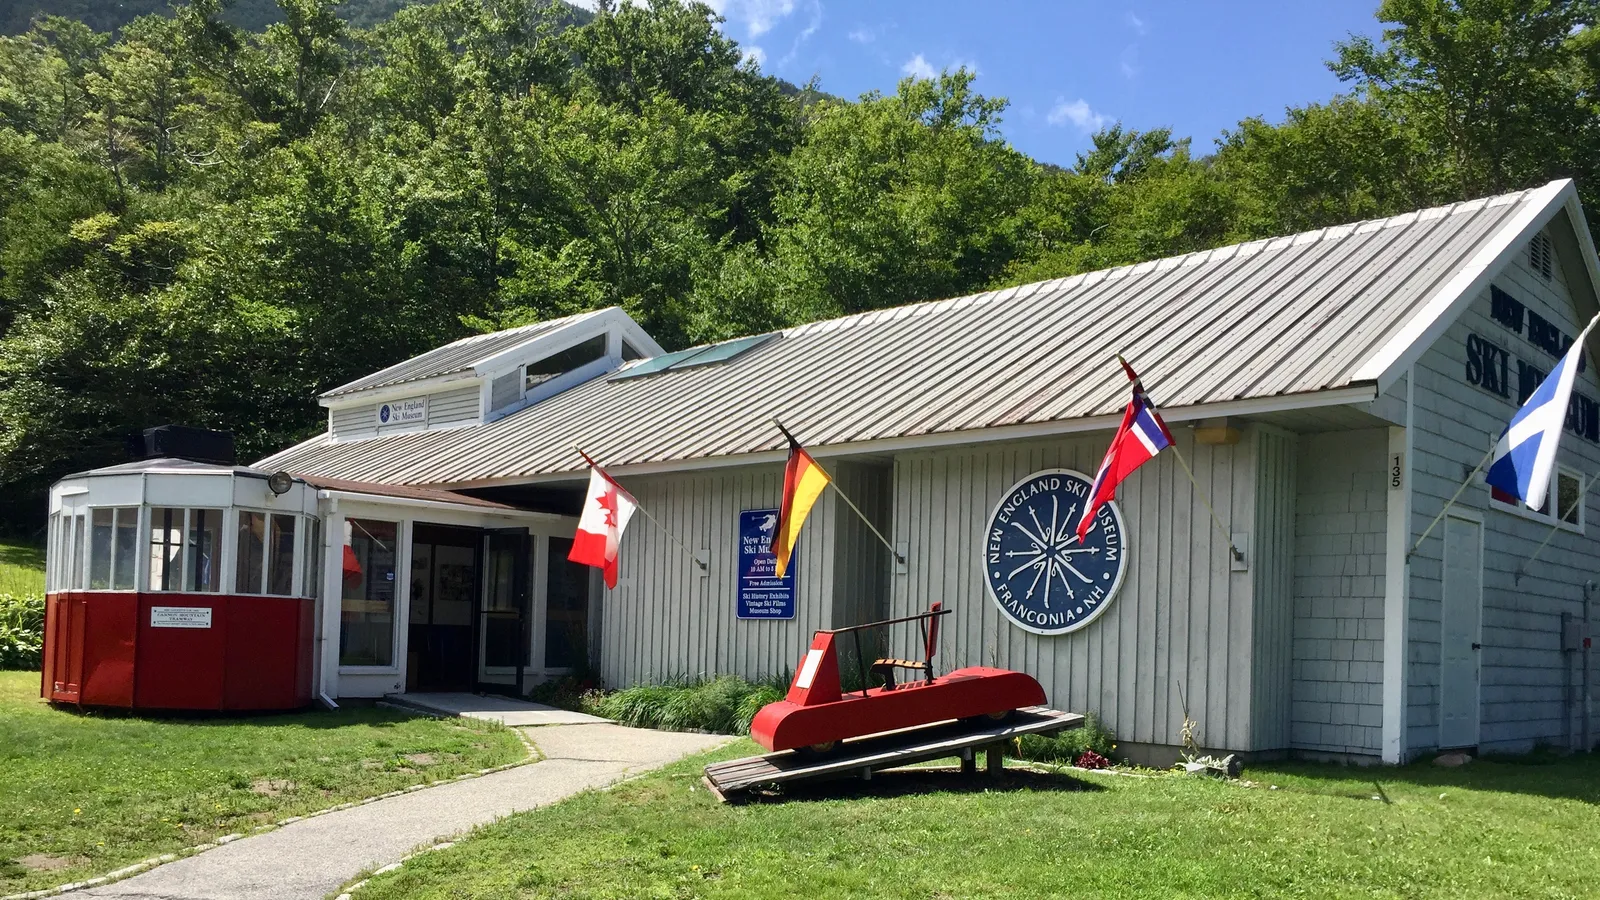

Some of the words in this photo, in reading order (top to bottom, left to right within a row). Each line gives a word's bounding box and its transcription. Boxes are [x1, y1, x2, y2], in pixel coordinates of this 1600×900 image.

[1466, 333, 1510, 399] SKI
[1516, 359, 1600, 444] MEUM
[391, 404, 402, 412] New
[404, 399, 425, 411] England
[392, 412, 400, 421] Ski
[401, 411, 423, 420] Museum
[1392, 456, 1401, 487] 135
[990, 527, 1003, 564] NEW
[999, 478, 1060, 524] ENGLAND
[1065, 479, 1087, 498] SKI
[1096, 504, 1117, 561] USEUM
[743, 535, 759, 545] New
[743, 545, 756, 554] Ski
[753, 558, 766, 566] Open
[996, 583, 1076, 626] FRANCONIA
[1083, 585, 1105, 610] NH
[769, 607, 782, 615] Shop
